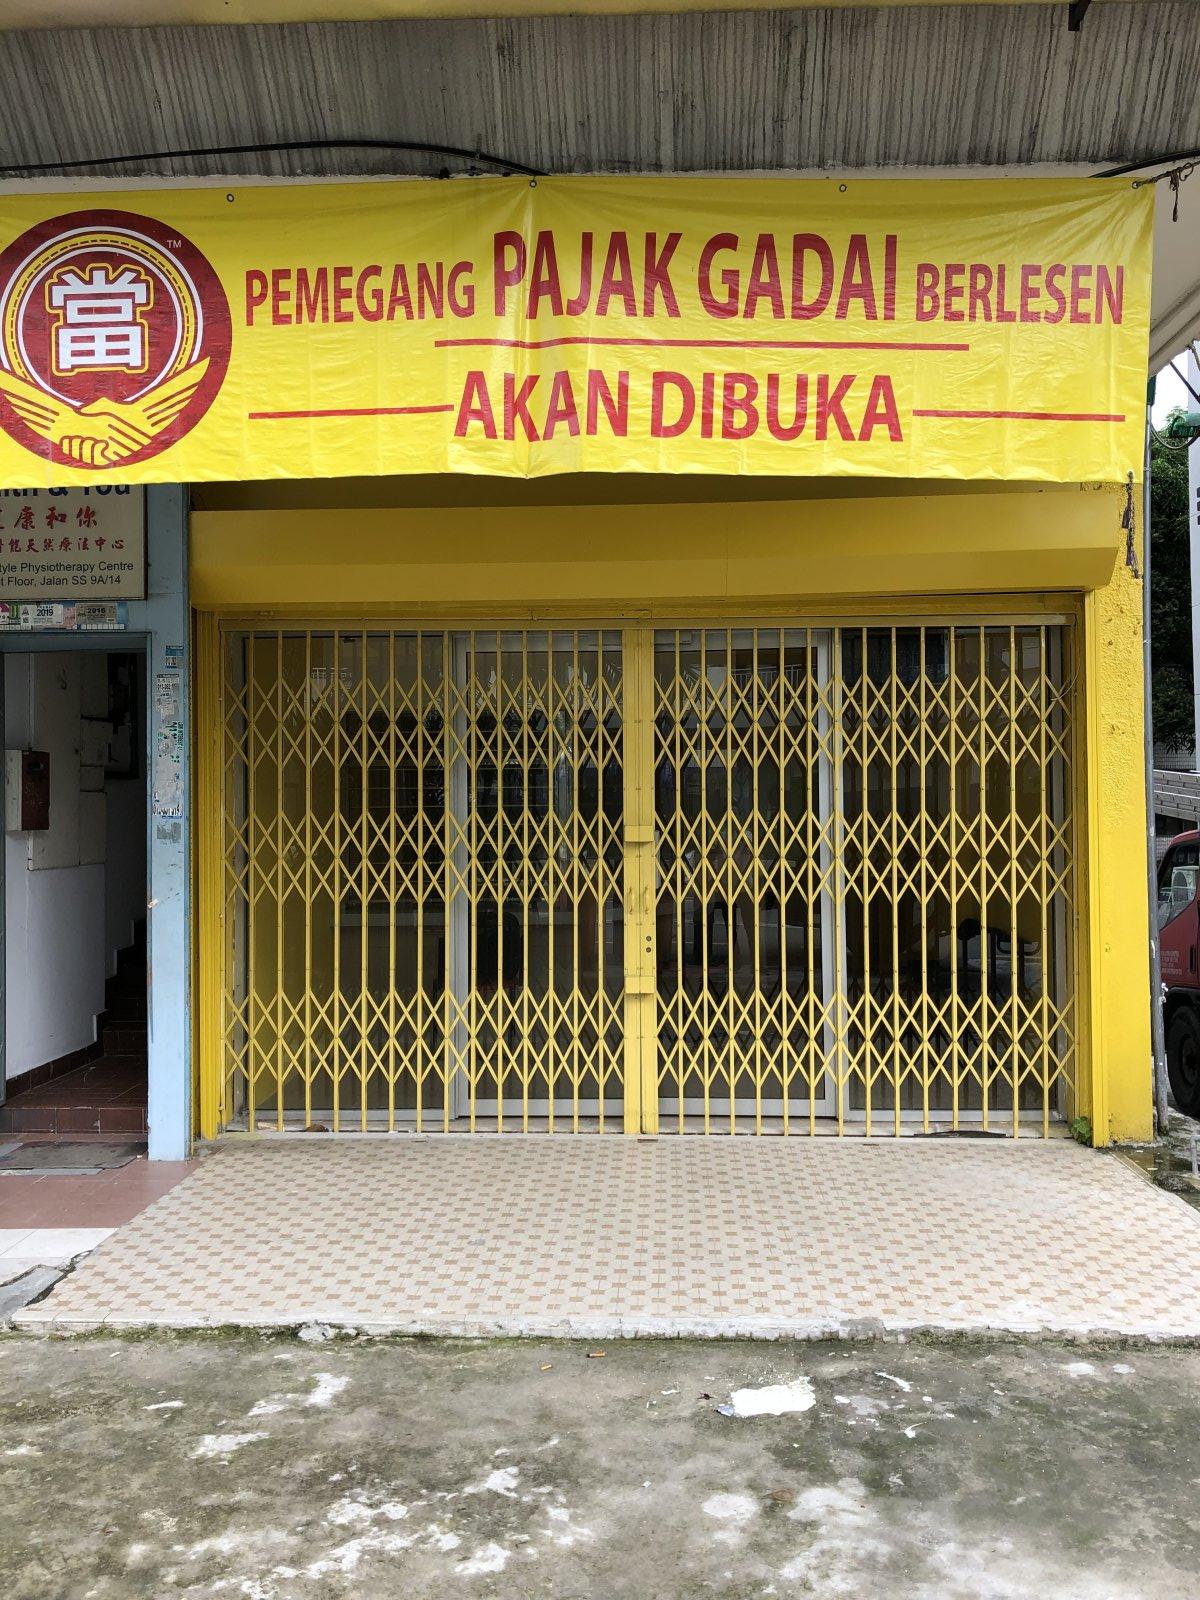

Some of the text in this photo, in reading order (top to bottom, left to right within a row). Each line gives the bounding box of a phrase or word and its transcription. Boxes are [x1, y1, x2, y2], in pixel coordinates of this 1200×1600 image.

[166, 240, 182, 249] TM
[245, 230, 1125, 326] PEMEGANG PAJAK GADAI BERLESEN
[52, 270, 147, 369] 當
[454, 369, 904, 442] AKAN DIBUKA
[20, 561, 95, 575] Physiotherapy
[98, 561, 134, 572] Centre
[7, 576, 37, 587] Floor,
[40, 576, 68, 586] Jalan
[71, 575, 87, 585] SS
[90, 575, 121, 585] 9A/14
[36, 608, 54, 617] 2019
